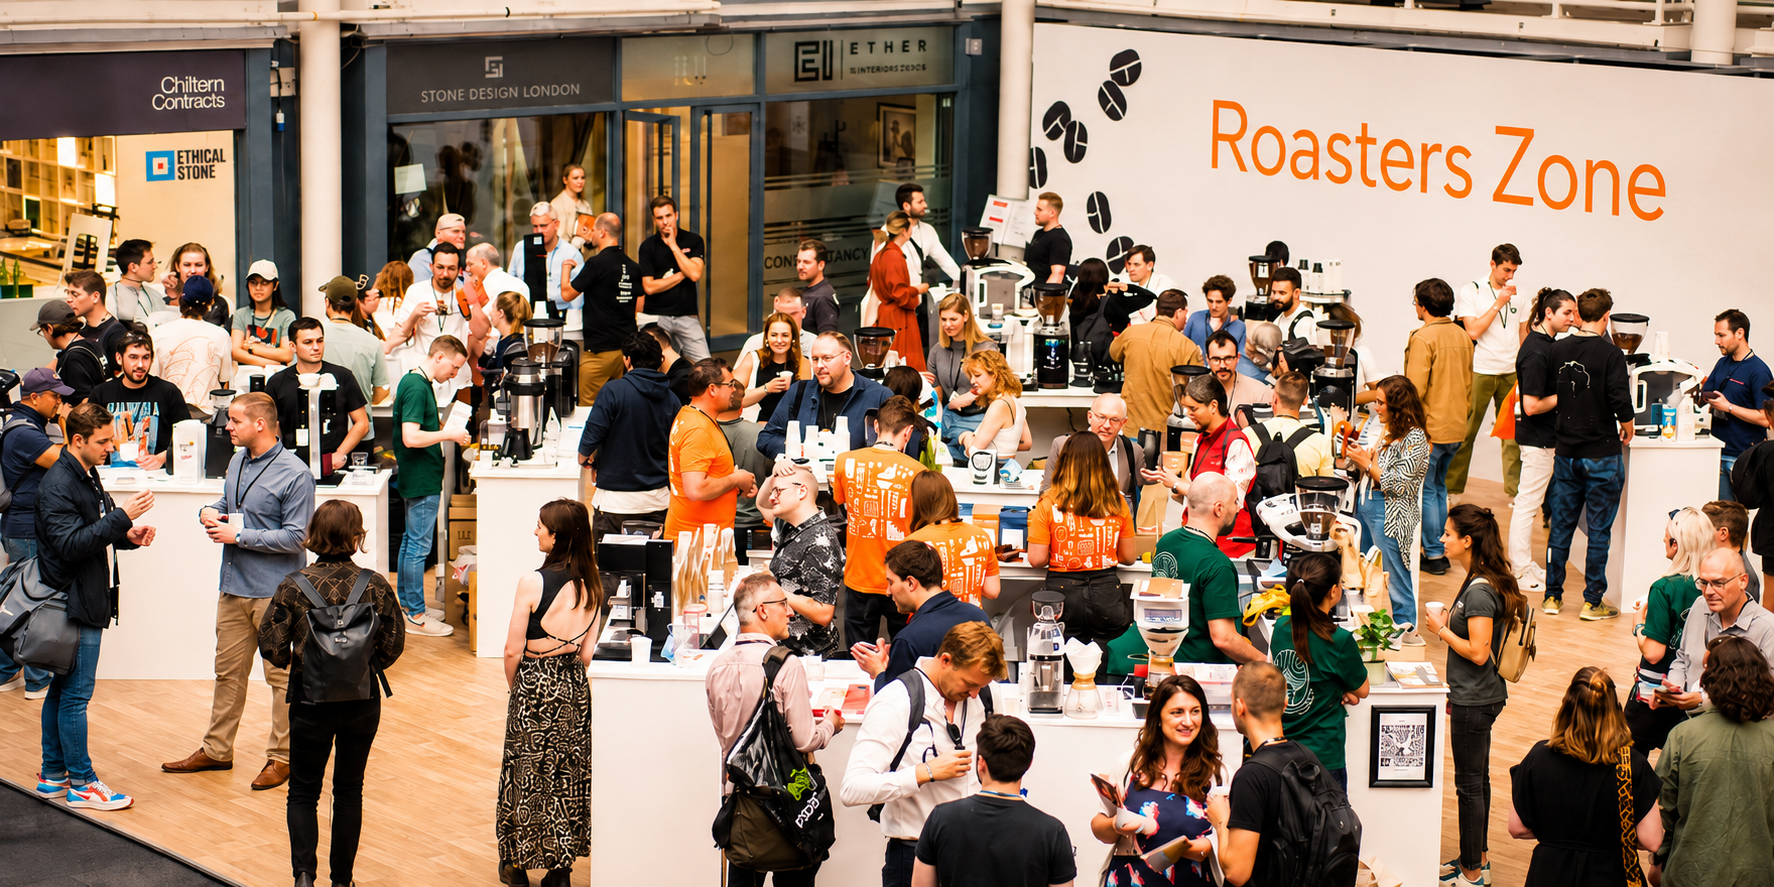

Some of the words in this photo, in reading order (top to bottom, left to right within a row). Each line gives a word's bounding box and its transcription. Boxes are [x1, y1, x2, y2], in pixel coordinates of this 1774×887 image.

[850, 39, 926, 55] ETHER
[161, 76, 225, 94] Chiltern
[421, 88, 465, 103] STONE
[469, 86, 519, 101] DESIGN
[523, 83, 580, 98] LONDON
[152, 93, 226, 111] Contracts
[177, 148, 226, 165] ETHICAL
[1211, 99, 1472, 199] Roasters
[1493, 125, 1666, 221] Zone
[177, 165, 216, 180] STONE
